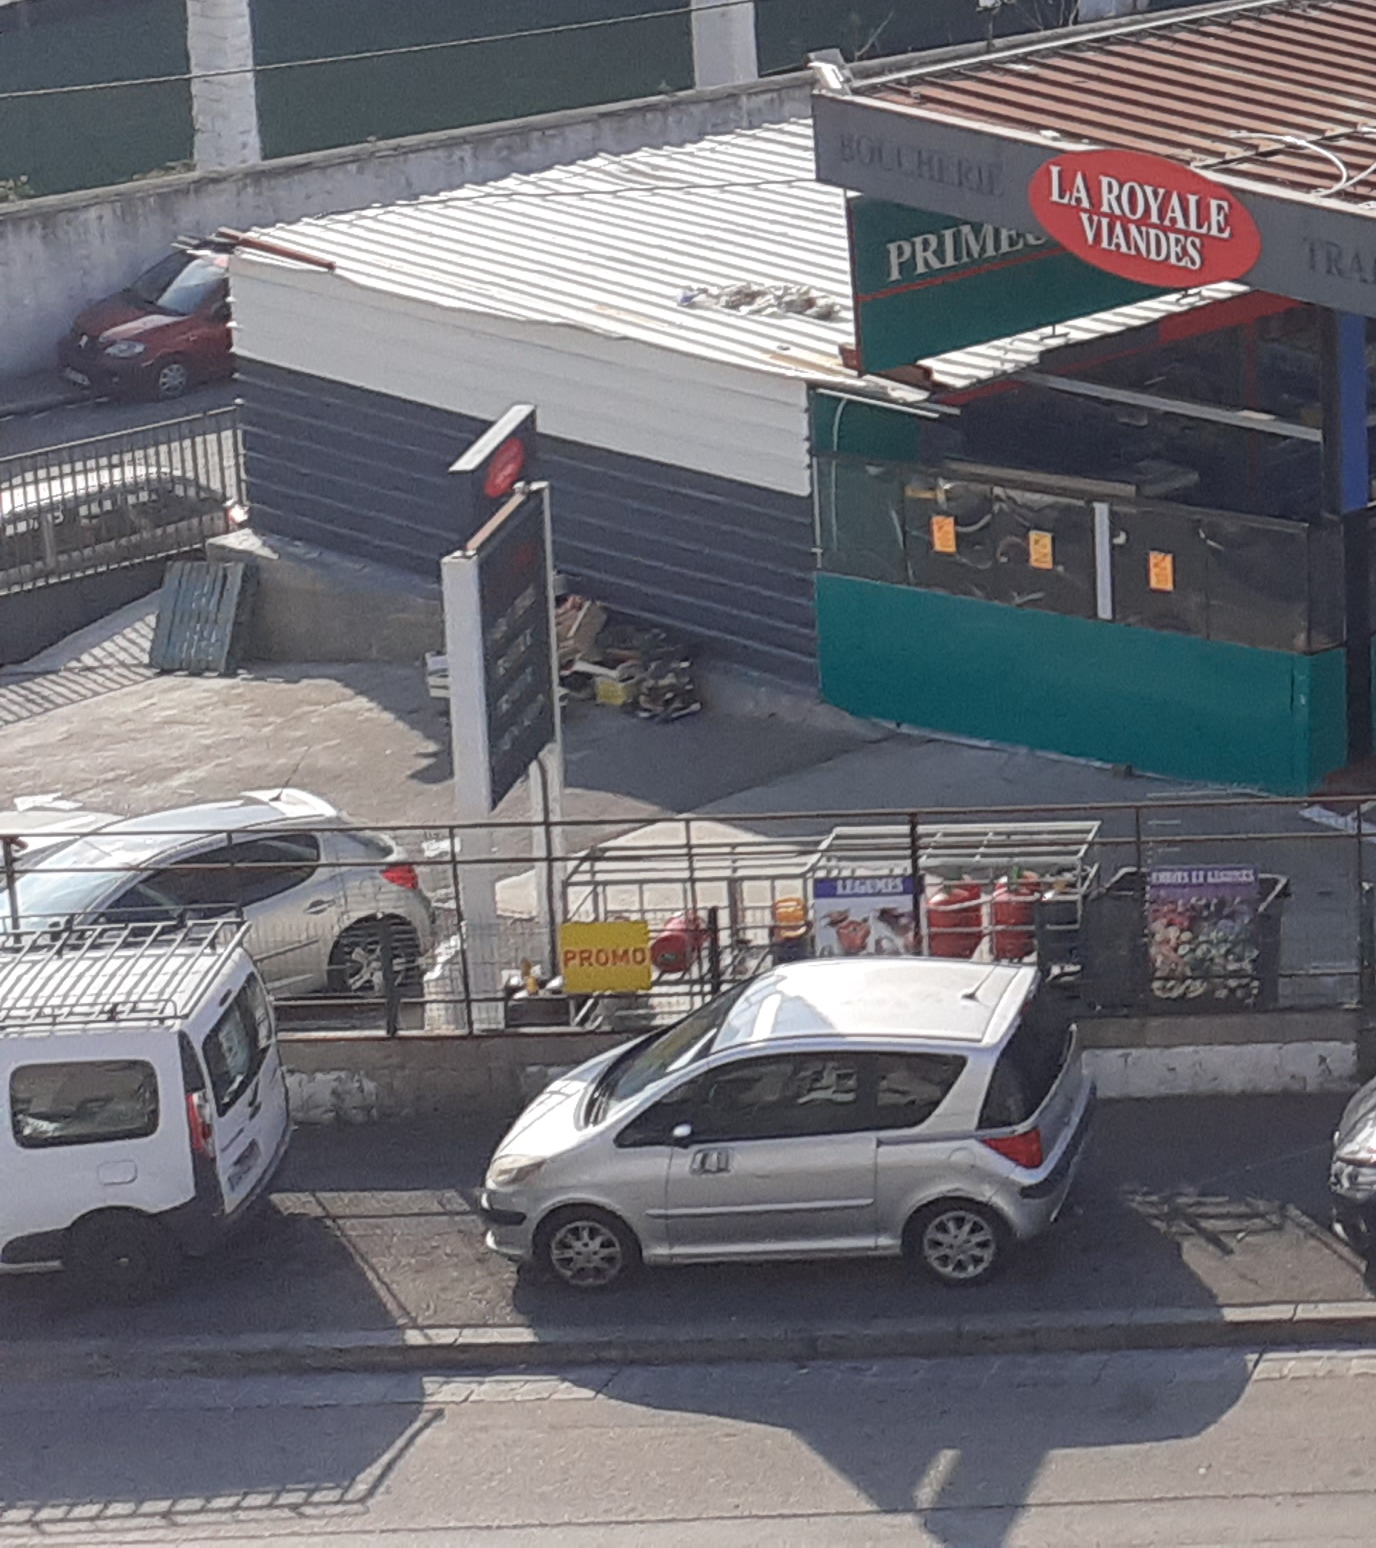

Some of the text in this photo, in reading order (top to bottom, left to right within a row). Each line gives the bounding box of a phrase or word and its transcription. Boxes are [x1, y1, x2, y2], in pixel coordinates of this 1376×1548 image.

[840, 132, 1006, 199] BOUCHERIE
[1050, 165, 1232, 239] LA ROYALE
[1080, 212, 1202, 271] VIANDES
[563, 947, 647, 968] PROMO
